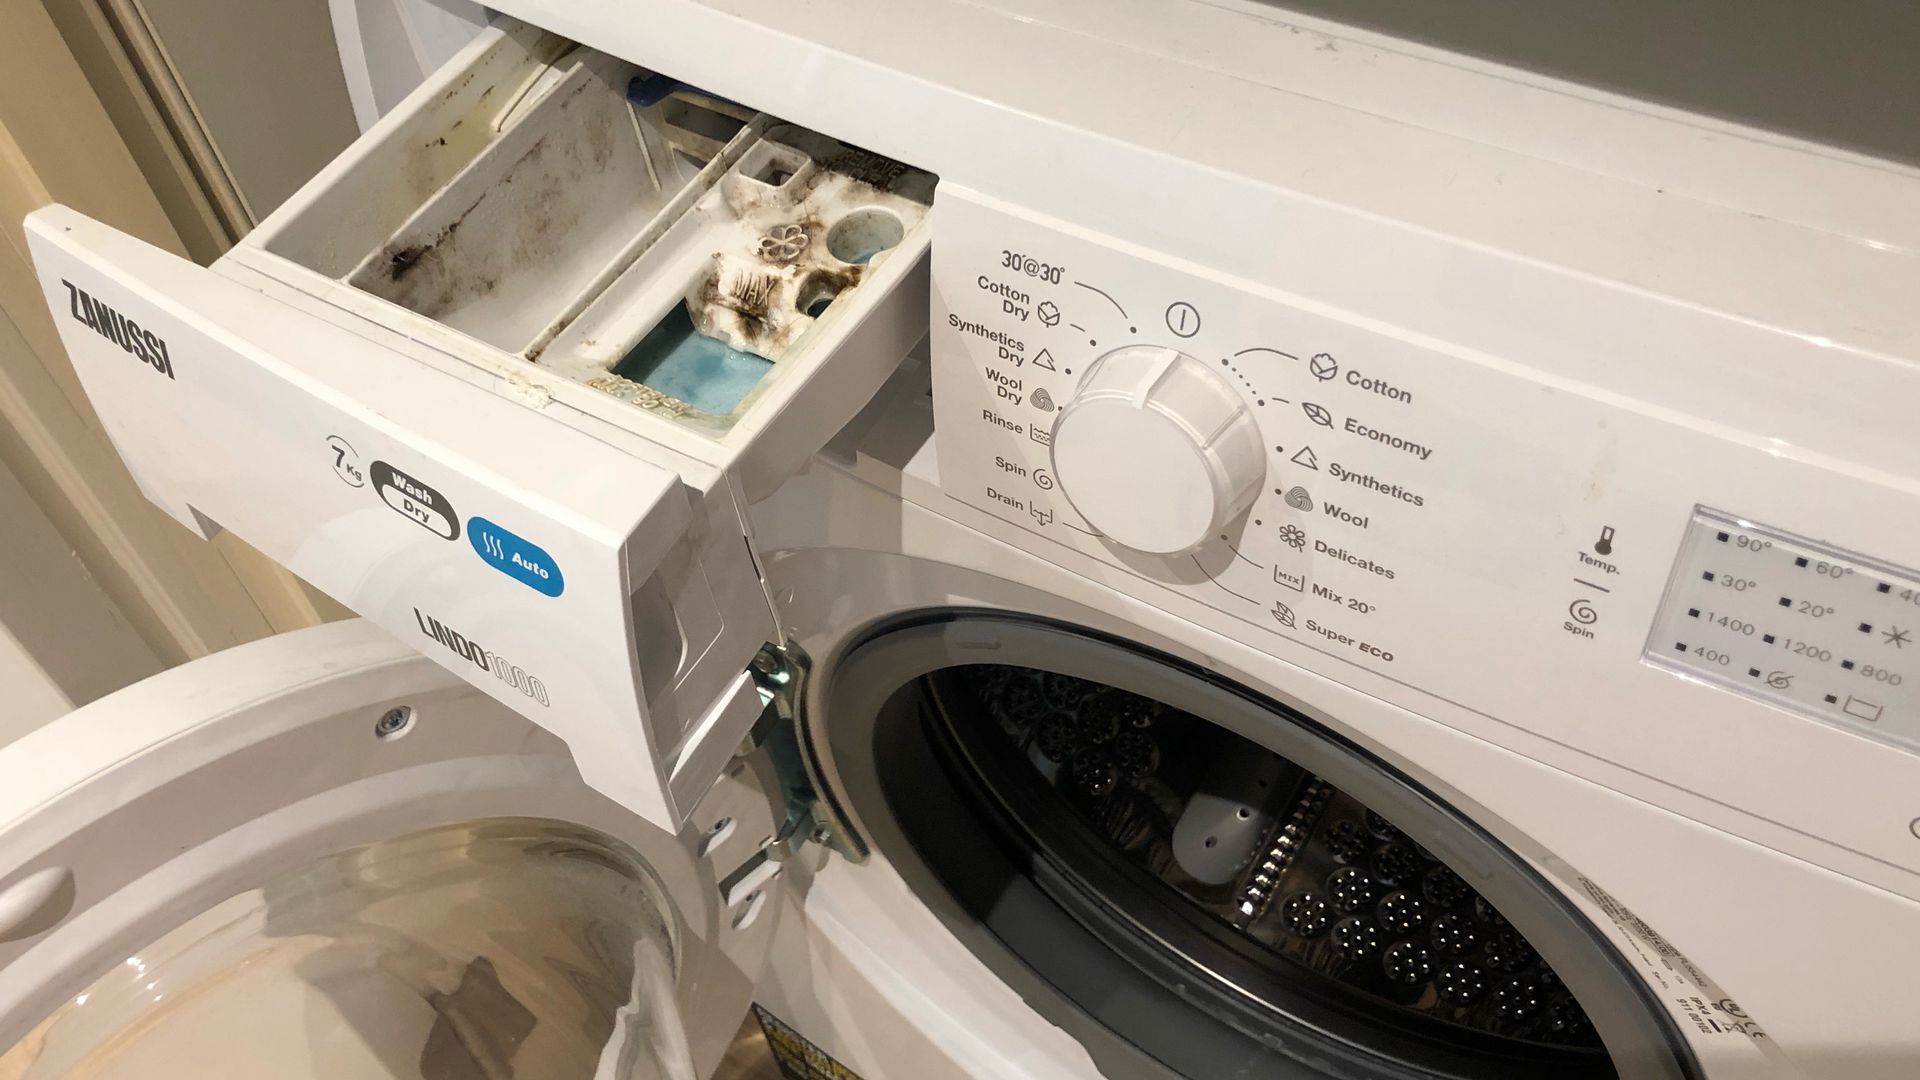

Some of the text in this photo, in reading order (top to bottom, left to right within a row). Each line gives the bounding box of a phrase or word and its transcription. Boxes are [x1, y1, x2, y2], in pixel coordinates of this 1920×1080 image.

[977, 275, 1030, 305] Cotton
[1002, 299, 1030, 322] Dry
[61, 277, 176, 381] ZANUSSI
[948, 313, 1025, 352] Synthetics
[998, 346, 1024, 367] Dry
[985, 366, 1022, 391] Wool
[1346, 370, 1412, 405] Cotton
[997, 385, 1022, 405] Dry
[982, 410, 1023, 434] Rinse
[1344, 417, 1432, 460] Economy
[331, 444, 345, 468] 7
[995, 456, 1026, 478] Spin
[391, 471, 433, 505] Wash
[1328, 462, 1424, 507] Synthetics
[403, 498, 430, 523] Dry
[986, 487, 1024, 511] Drain
[1323, 501, 1368, 529] Wool
[512, 552, 549, 579] Auto
[1314, 540, 1395, 580] Delicates
[1578, 551, 1621, 576] Temp.
[1736, 535, 1772, 552] 90°
[1816, 561, 1853, 579] 60°
[1279, 571, 1299, 584] MIX
[1312, 583, 1376, 615] Mix 20°
[1720, 574, 1835, 618] 30° 20°
[1305, 619, 1355, 646] Super
[1563, 620, 1595, 640] Spin
[1693, 646, 1730, 666] 400
[1707, 610, 1902, 686] 1400 1200 800
[1689, 997, 1711, 1015] IPX4
